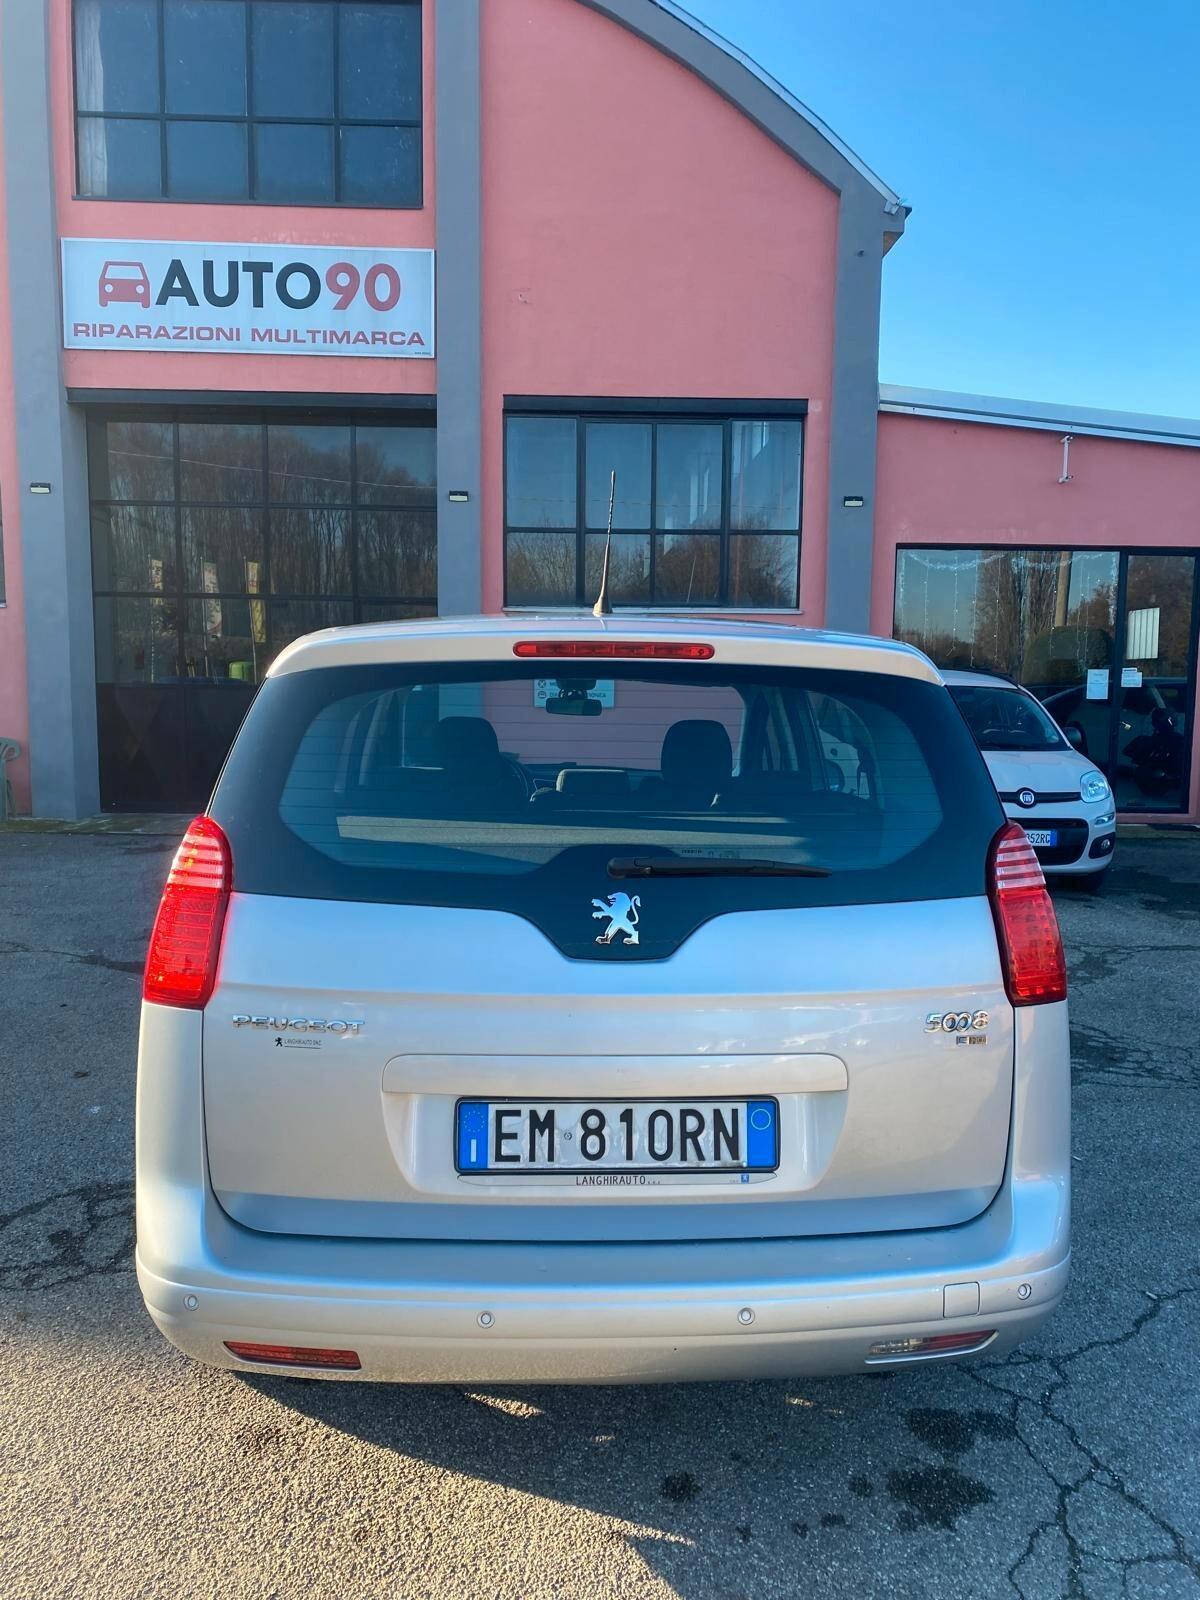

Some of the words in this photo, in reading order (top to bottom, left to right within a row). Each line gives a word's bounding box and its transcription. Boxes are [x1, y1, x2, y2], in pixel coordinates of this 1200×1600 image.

[155, 258, 401, 312] AUTO90
[73, 322, 241, 342] RIPARAZIONI
[250, 328, 425, 346] MULTIMARCA
[232, 1014, 365, 1034] PEUGEOT
[924, 1010, 989, 1033] 5008
[494, 1109, 555, 1163] EM
